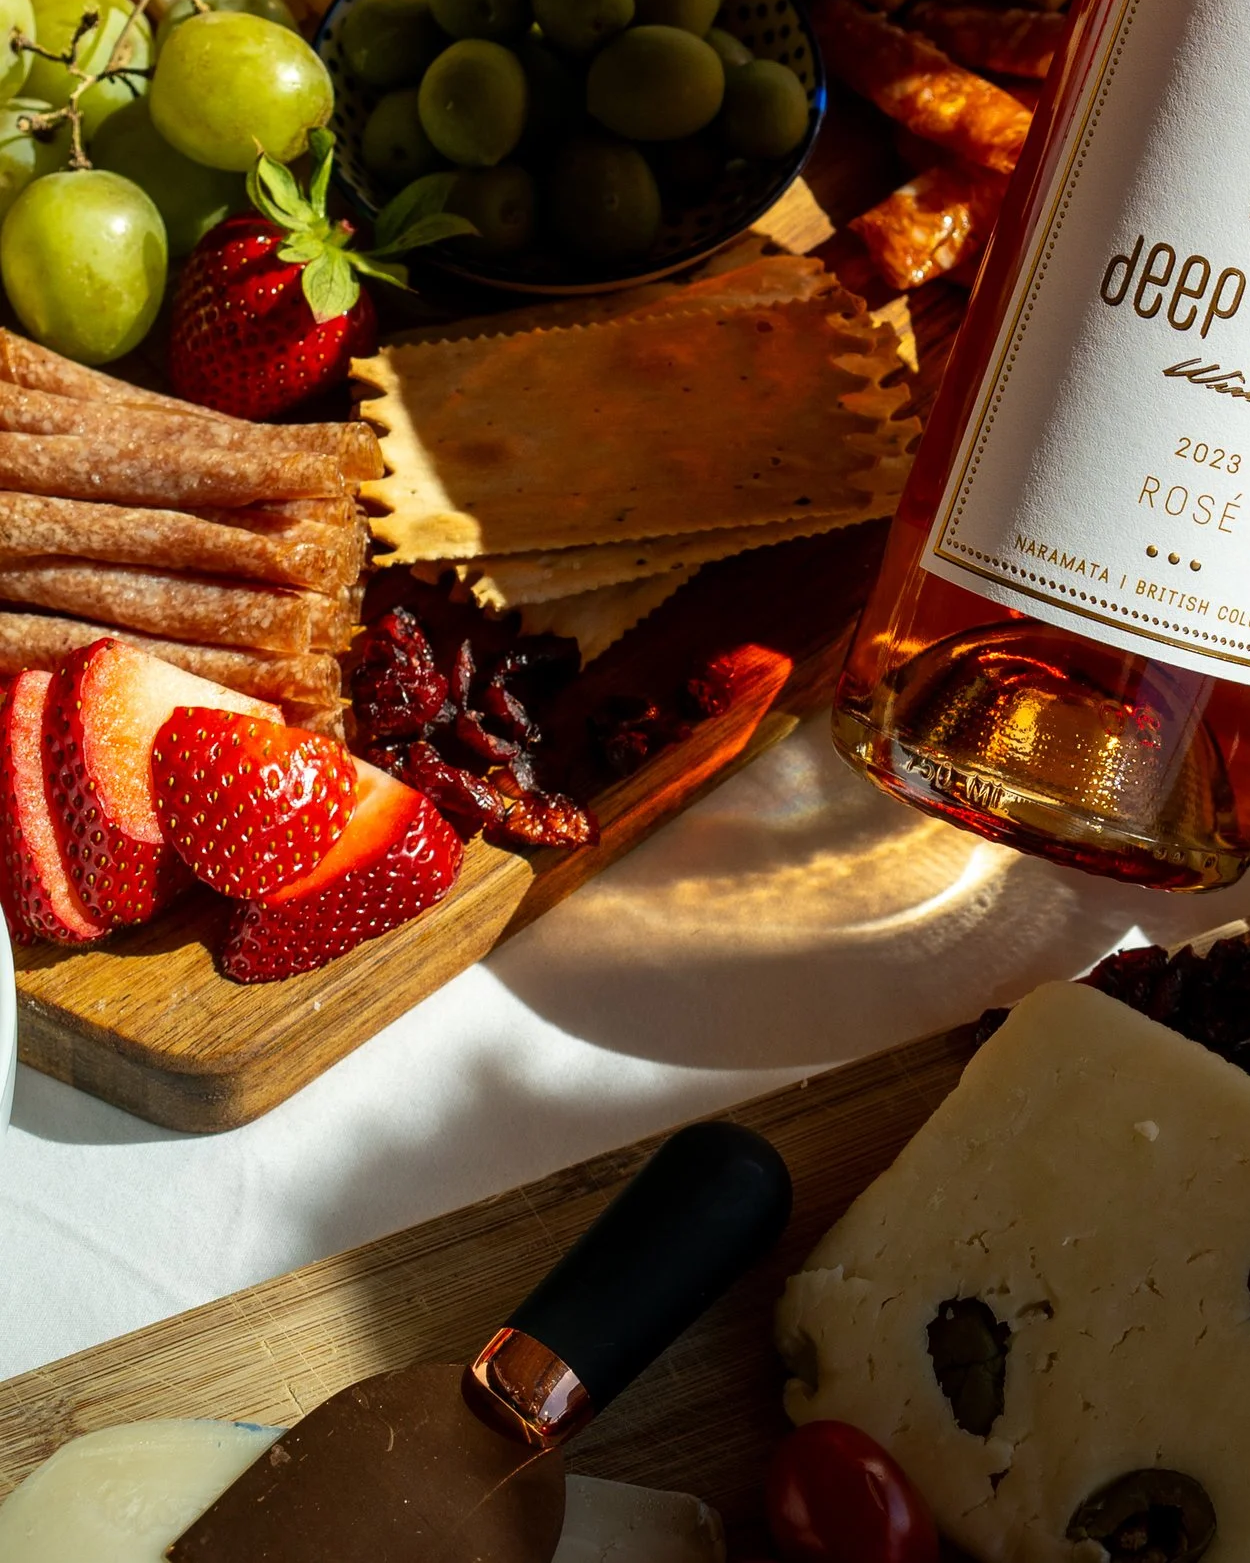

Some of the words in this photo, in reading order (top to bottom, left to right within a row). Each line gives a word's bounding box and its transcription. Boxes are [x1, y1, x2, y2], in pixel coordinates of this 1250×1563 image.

[1100, 234, 1246, 339] deep
[1175, 436, 1242, 474] 2023
[1138, 475, 1244, 533] ROSÉ
[1013, 533, 1110, 584] NARAMATA
[1135, 579, 1210, 616] BRITISH
